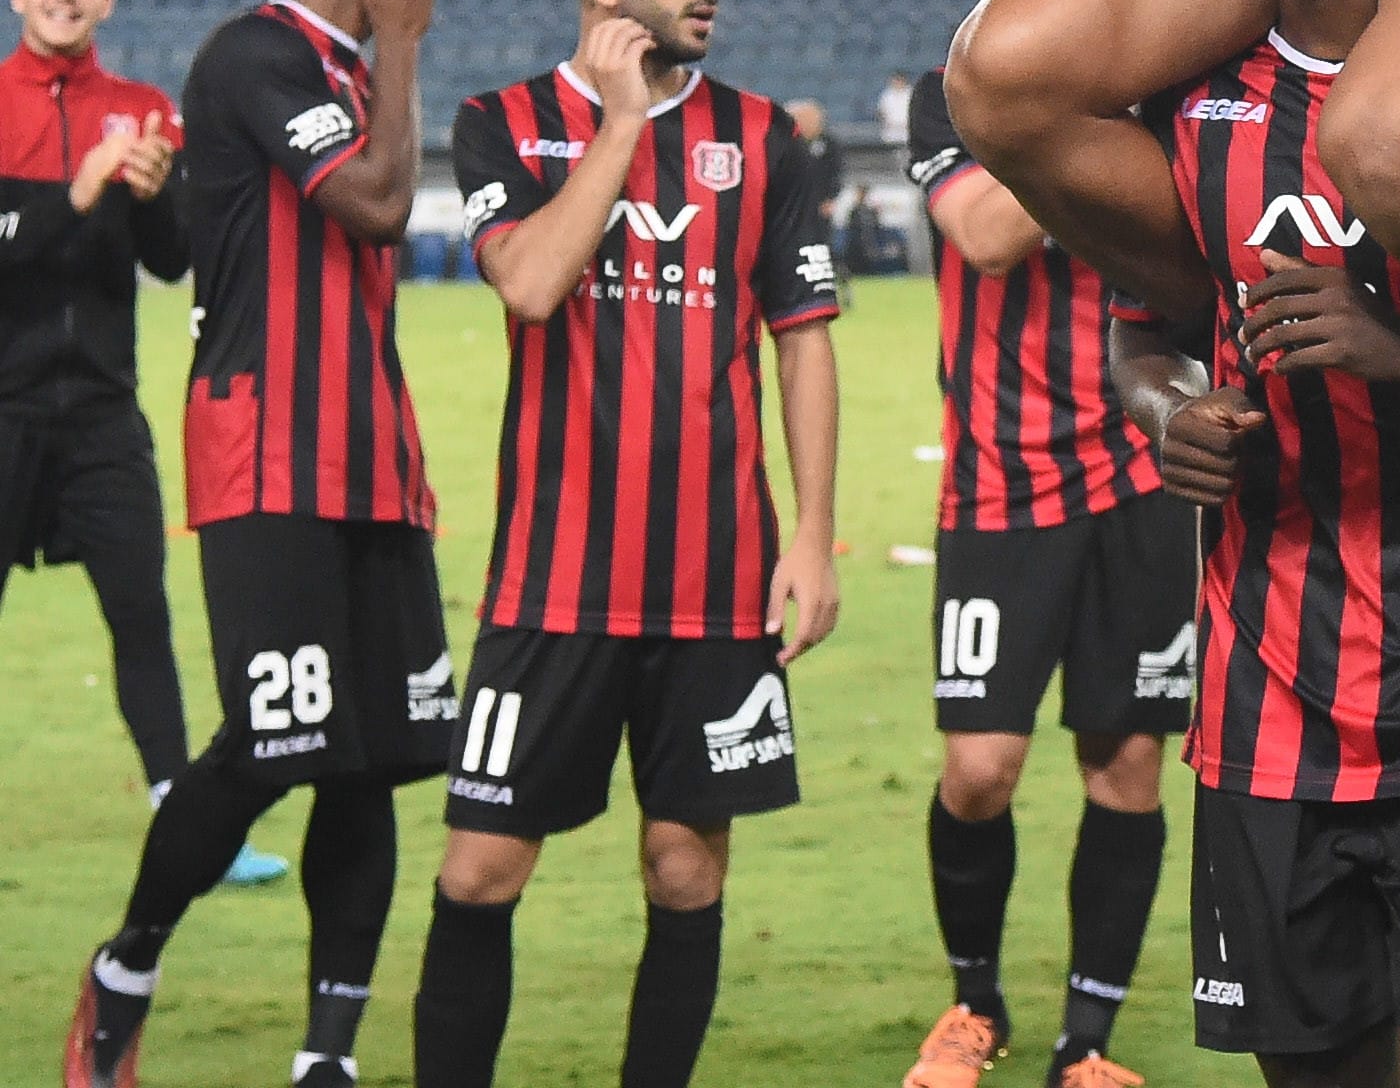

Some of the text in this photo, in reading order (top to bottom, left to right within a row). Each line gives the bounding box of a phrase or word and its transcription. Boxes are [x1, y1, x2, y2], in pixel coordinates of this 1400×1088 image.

[1183, 98, 1268, 124] LEGEA
[519, 139, 587, 159] LEGE
[583, 259, 717, 286] LLON
[940, 598, 1000, 676] 10
[248, 644, 333, 731] 28
[462, 686, 522, 777] 11
